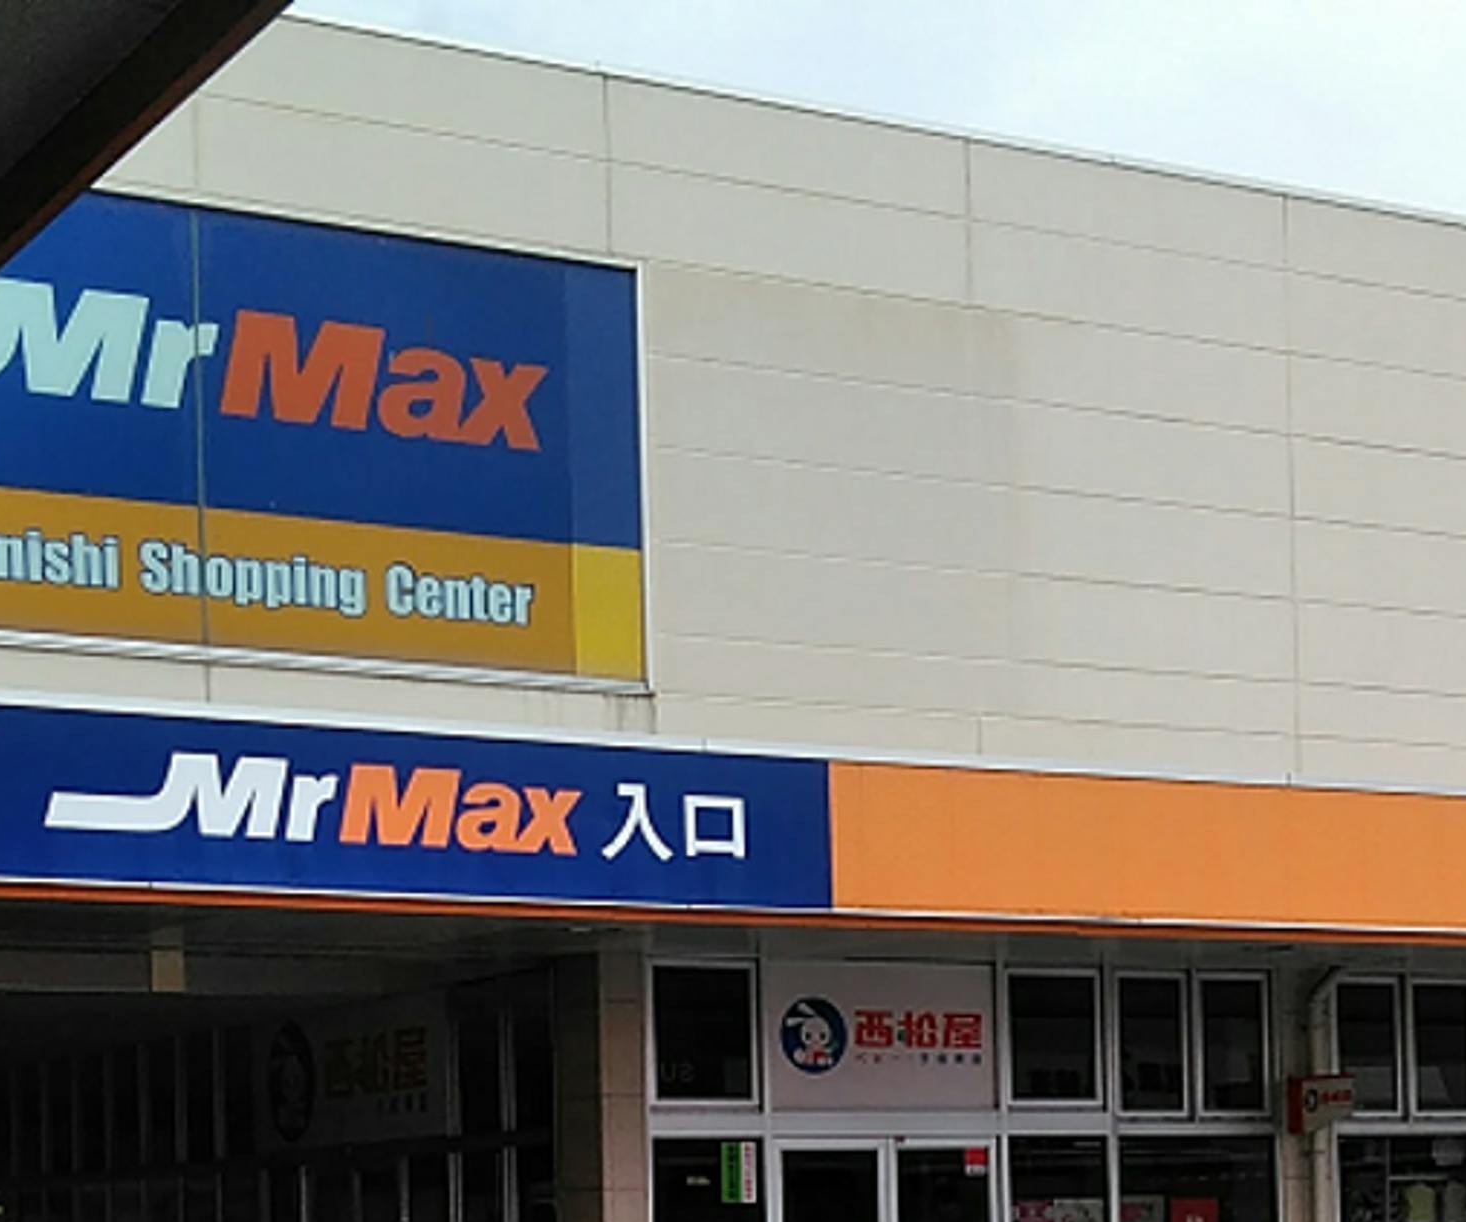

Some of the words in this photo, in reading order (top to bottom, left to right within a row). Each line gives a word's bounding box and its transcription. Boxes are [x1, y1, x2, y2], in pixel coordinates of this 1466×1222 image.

[137, 538, 367, 617] Shopping
[385, 562, 534, 626] Center
[44, 750, 582, 857] MrMax
[601, 782, 746, 862] 入口
[854, 1009, 982, 1048] 西松屋
